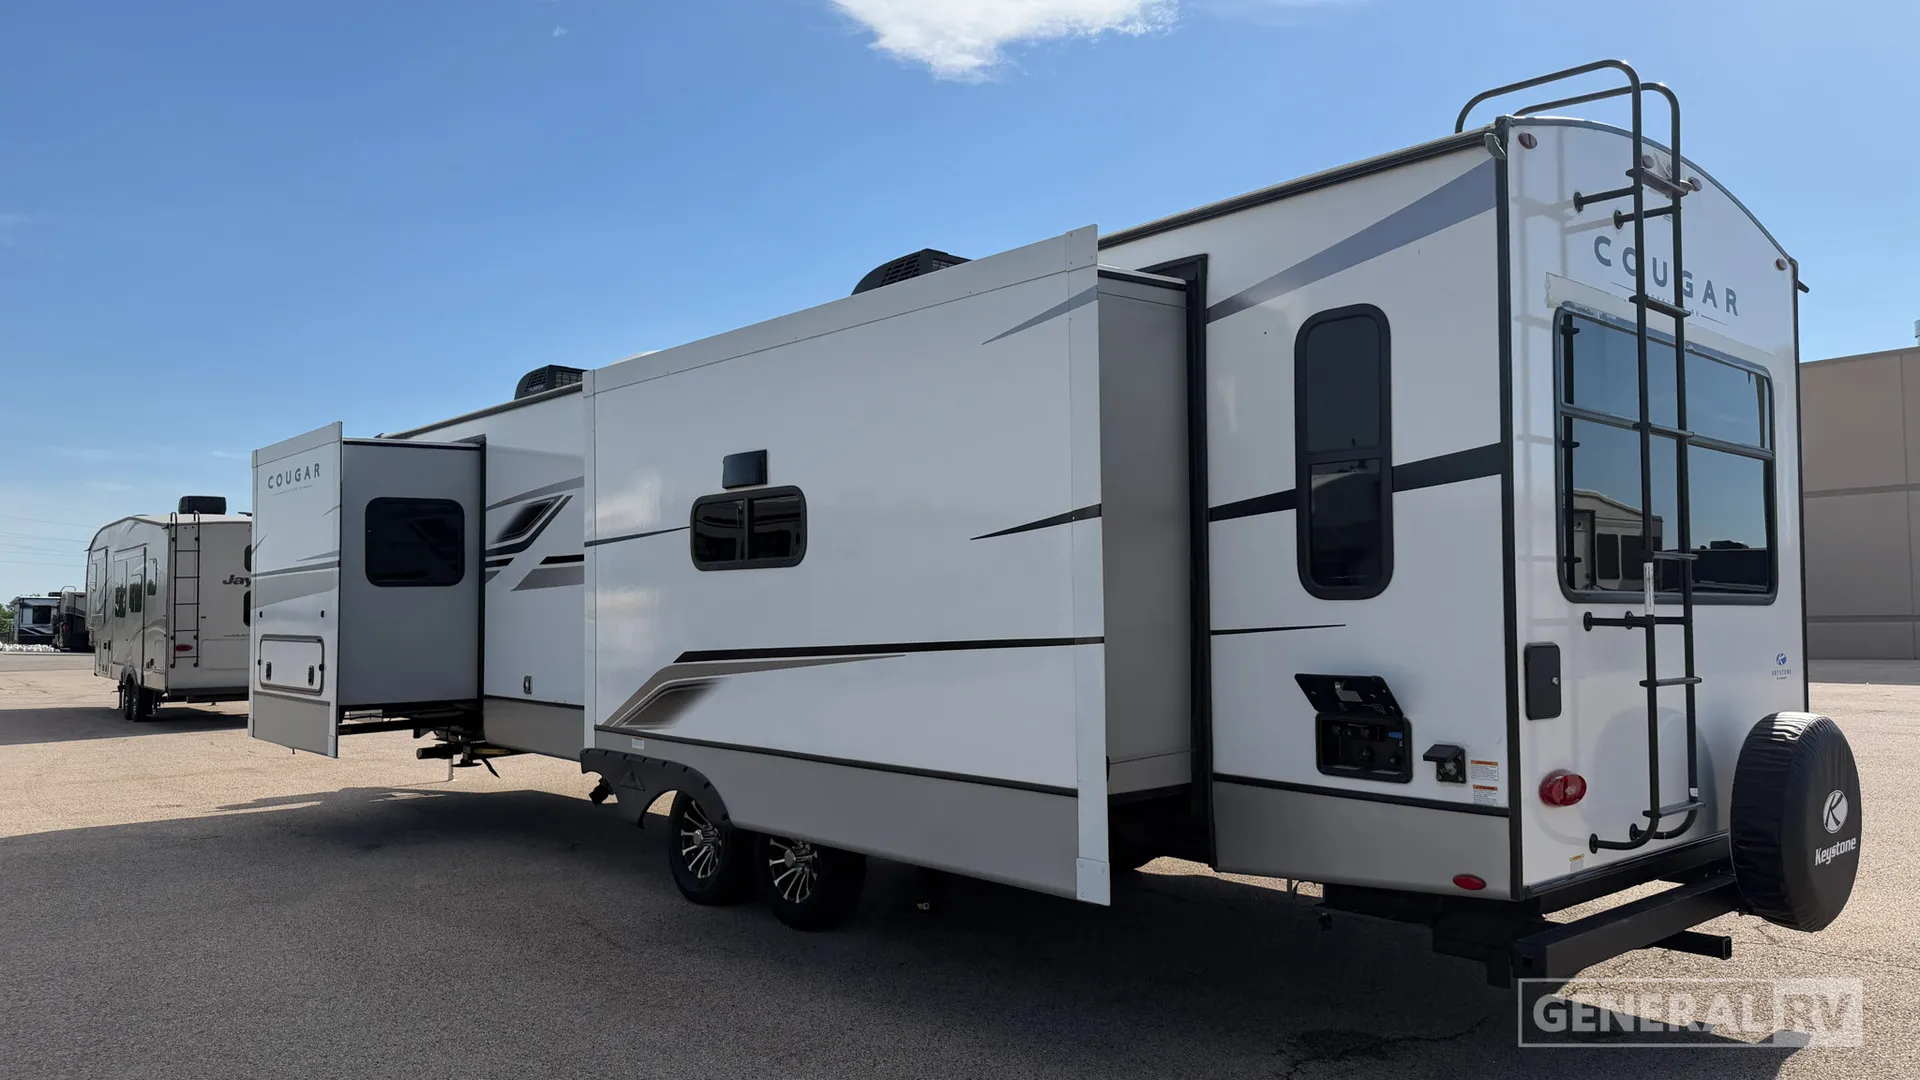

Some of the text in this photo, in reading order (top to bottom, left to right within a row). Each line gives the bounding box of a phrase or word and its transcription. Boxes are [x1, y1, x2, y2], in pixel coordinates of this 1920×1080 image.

[1594, 236, 1738, 316] COUGAR
[268, 463, 320, 489] COUGAR
[1815, 837, 1857, 866] Keystone
